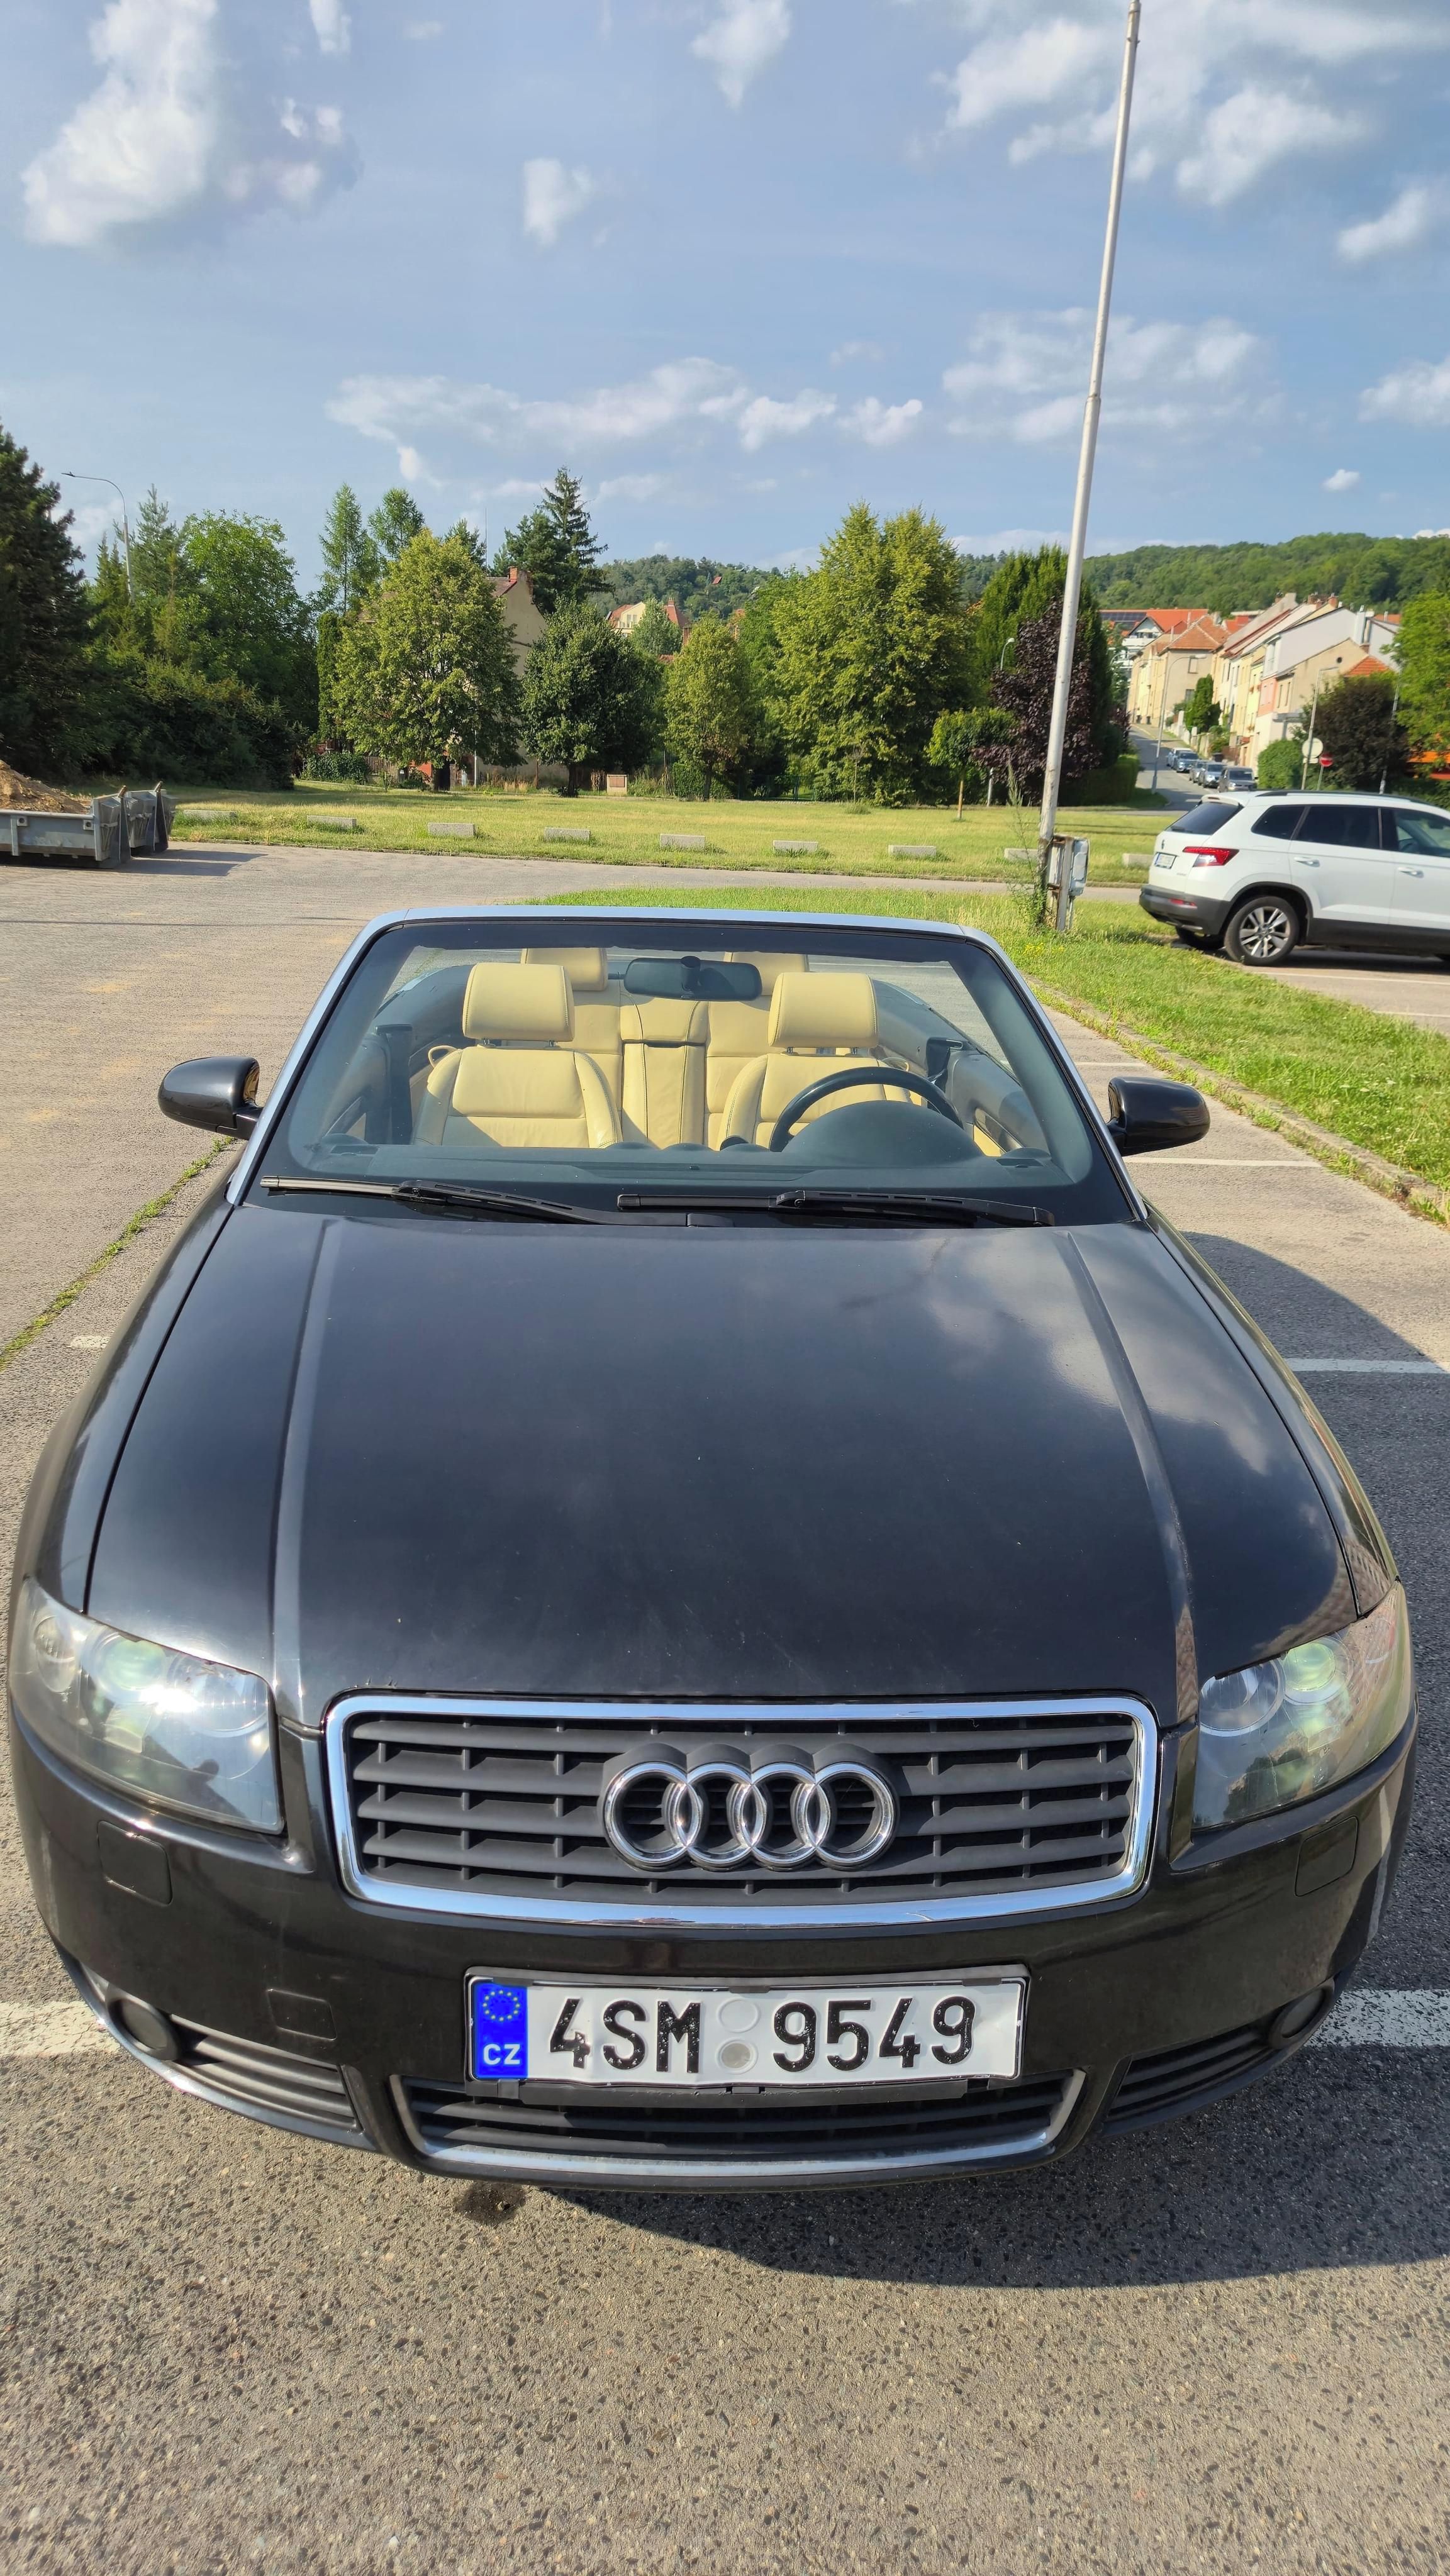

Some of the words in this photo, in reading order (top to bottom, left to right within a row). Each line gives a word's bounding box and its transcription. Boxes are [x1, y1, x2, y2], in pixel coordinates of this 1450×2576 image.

[482, 2043, 521, 2065] CZ
[550, 1997, 701, 2074] 4SM
[772, 1996, 976, 2072] 9549
